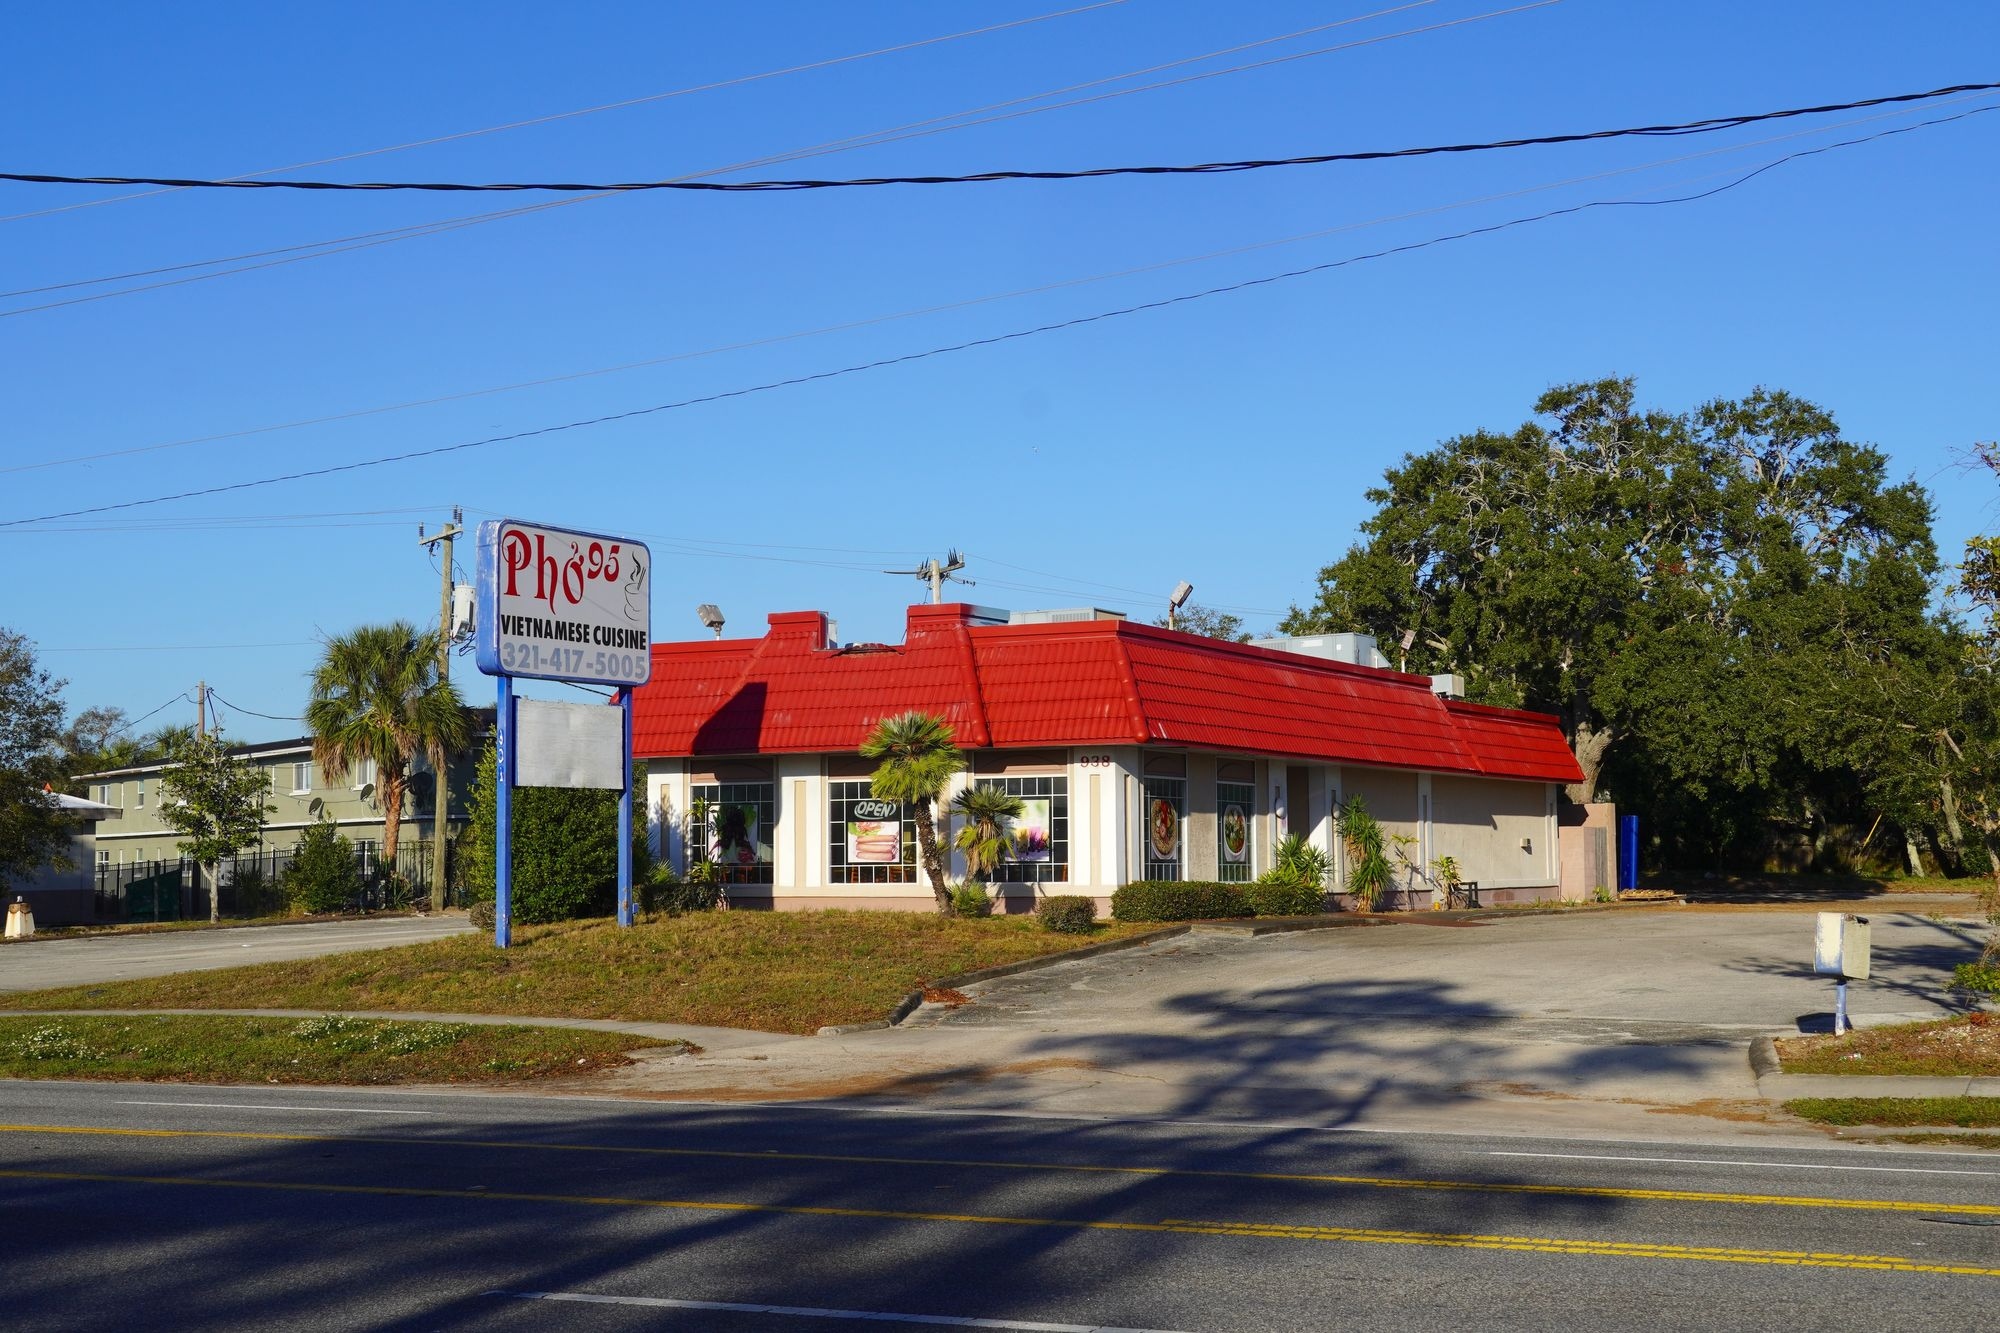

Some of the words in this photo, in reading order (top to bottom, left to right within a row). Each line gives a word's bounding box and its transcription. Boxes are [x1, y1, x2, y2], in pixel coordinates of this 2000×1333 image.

[587, 541, 620, 582] 95
[501, 614, 590, 643] VIETNAMESE
[593, 625, 646, 650] CUISINE
[503, 642, 645, 679] 321-417-5005
[1080, 756, 1110, 767] 938
[857, 801, 891, 817] OPEN
